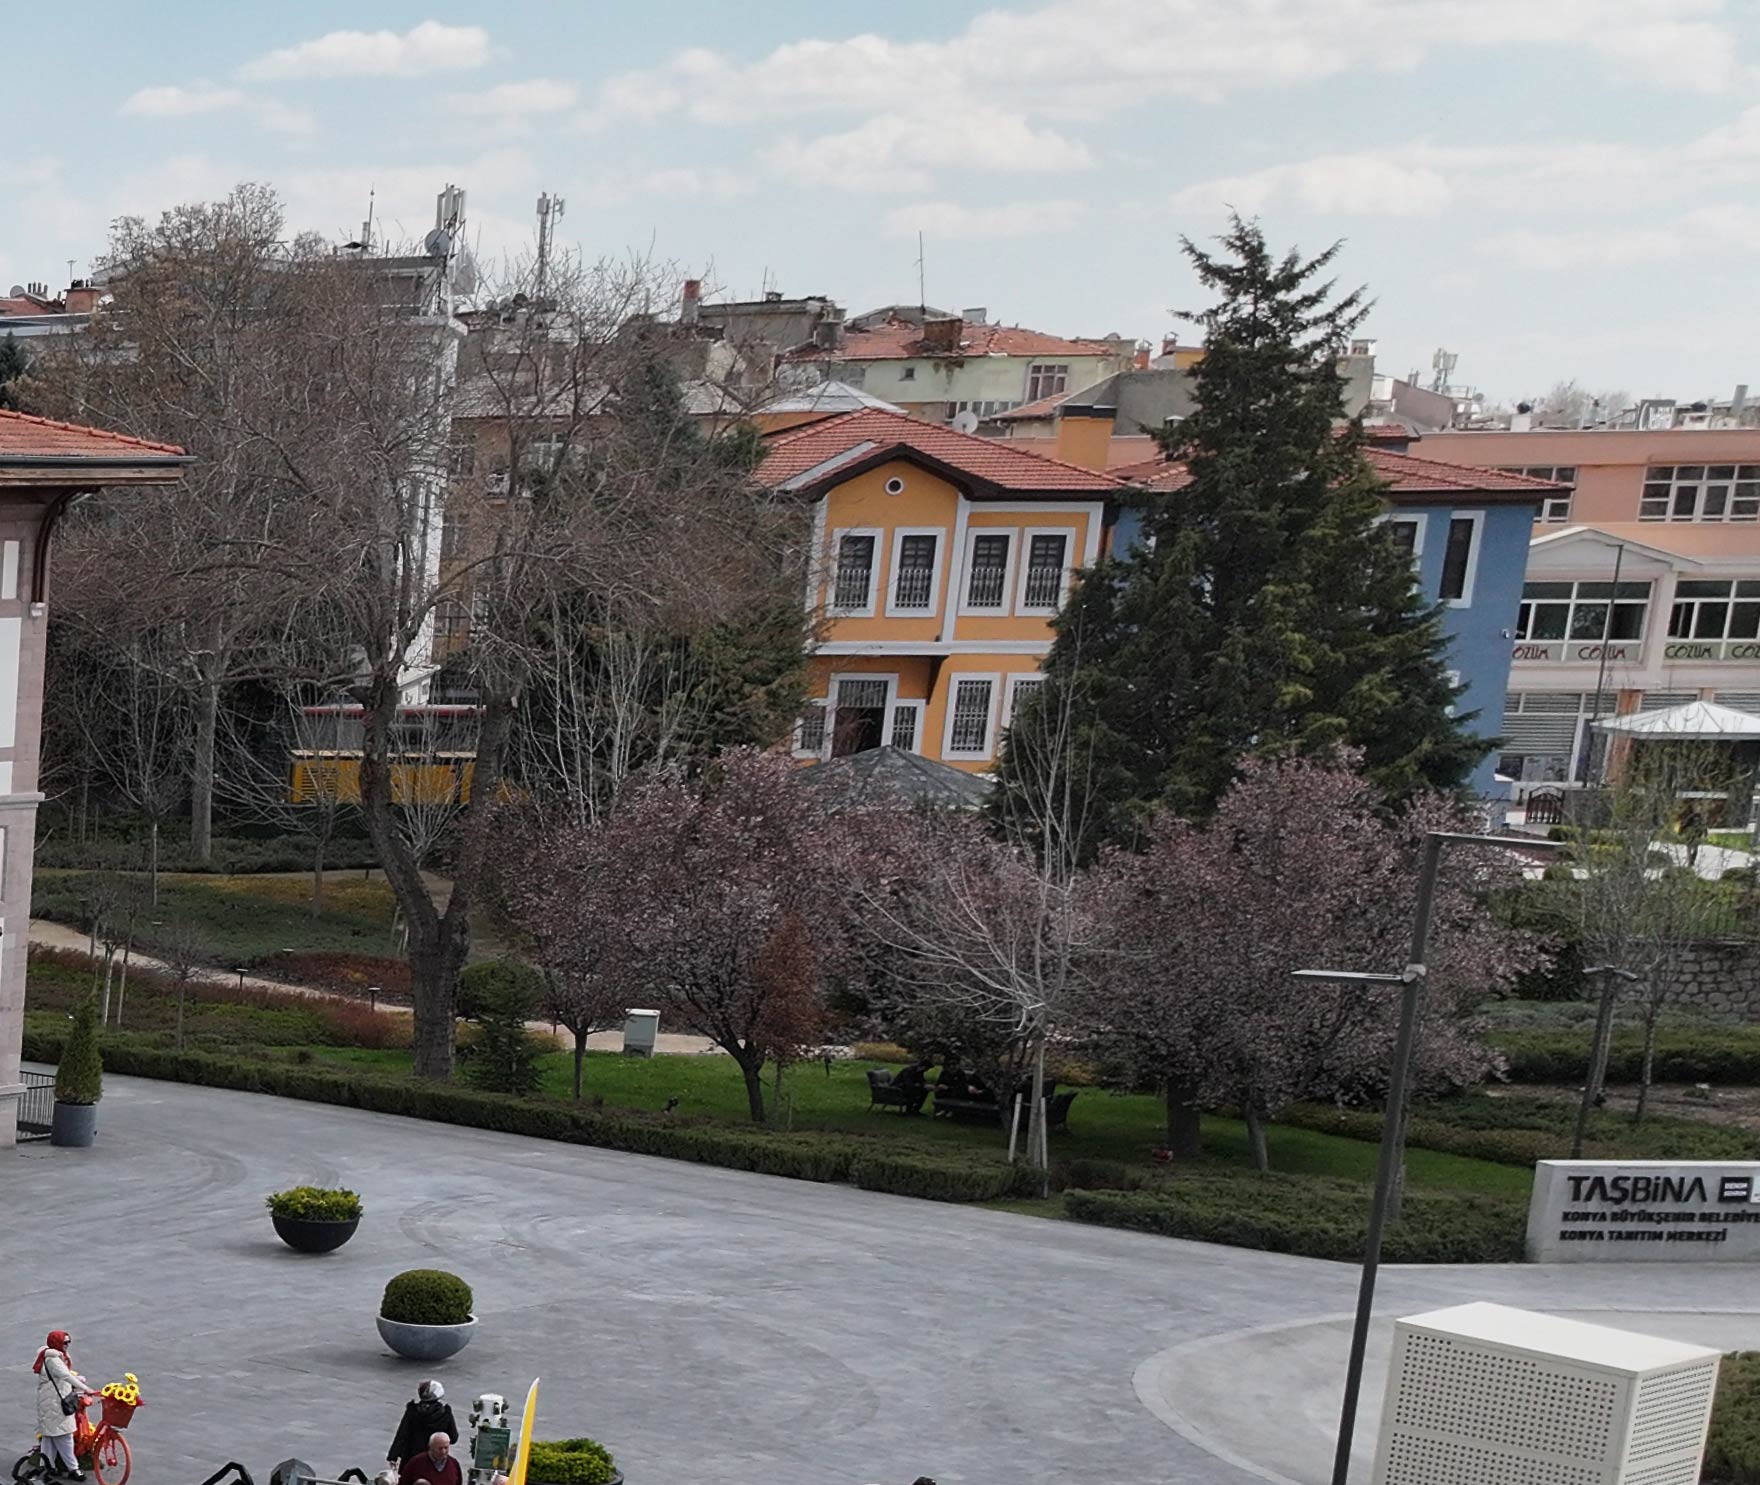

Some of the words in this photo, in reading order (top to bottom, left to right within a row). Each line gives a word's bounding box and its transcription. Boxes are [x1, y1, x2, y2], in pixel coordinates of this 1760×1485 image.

[1561, 1211, 1607, 1223] KONYA
[1559, 1230, 1604, 1241] KONYA
[1608, 1230, 1663, 1242] TANITIM
